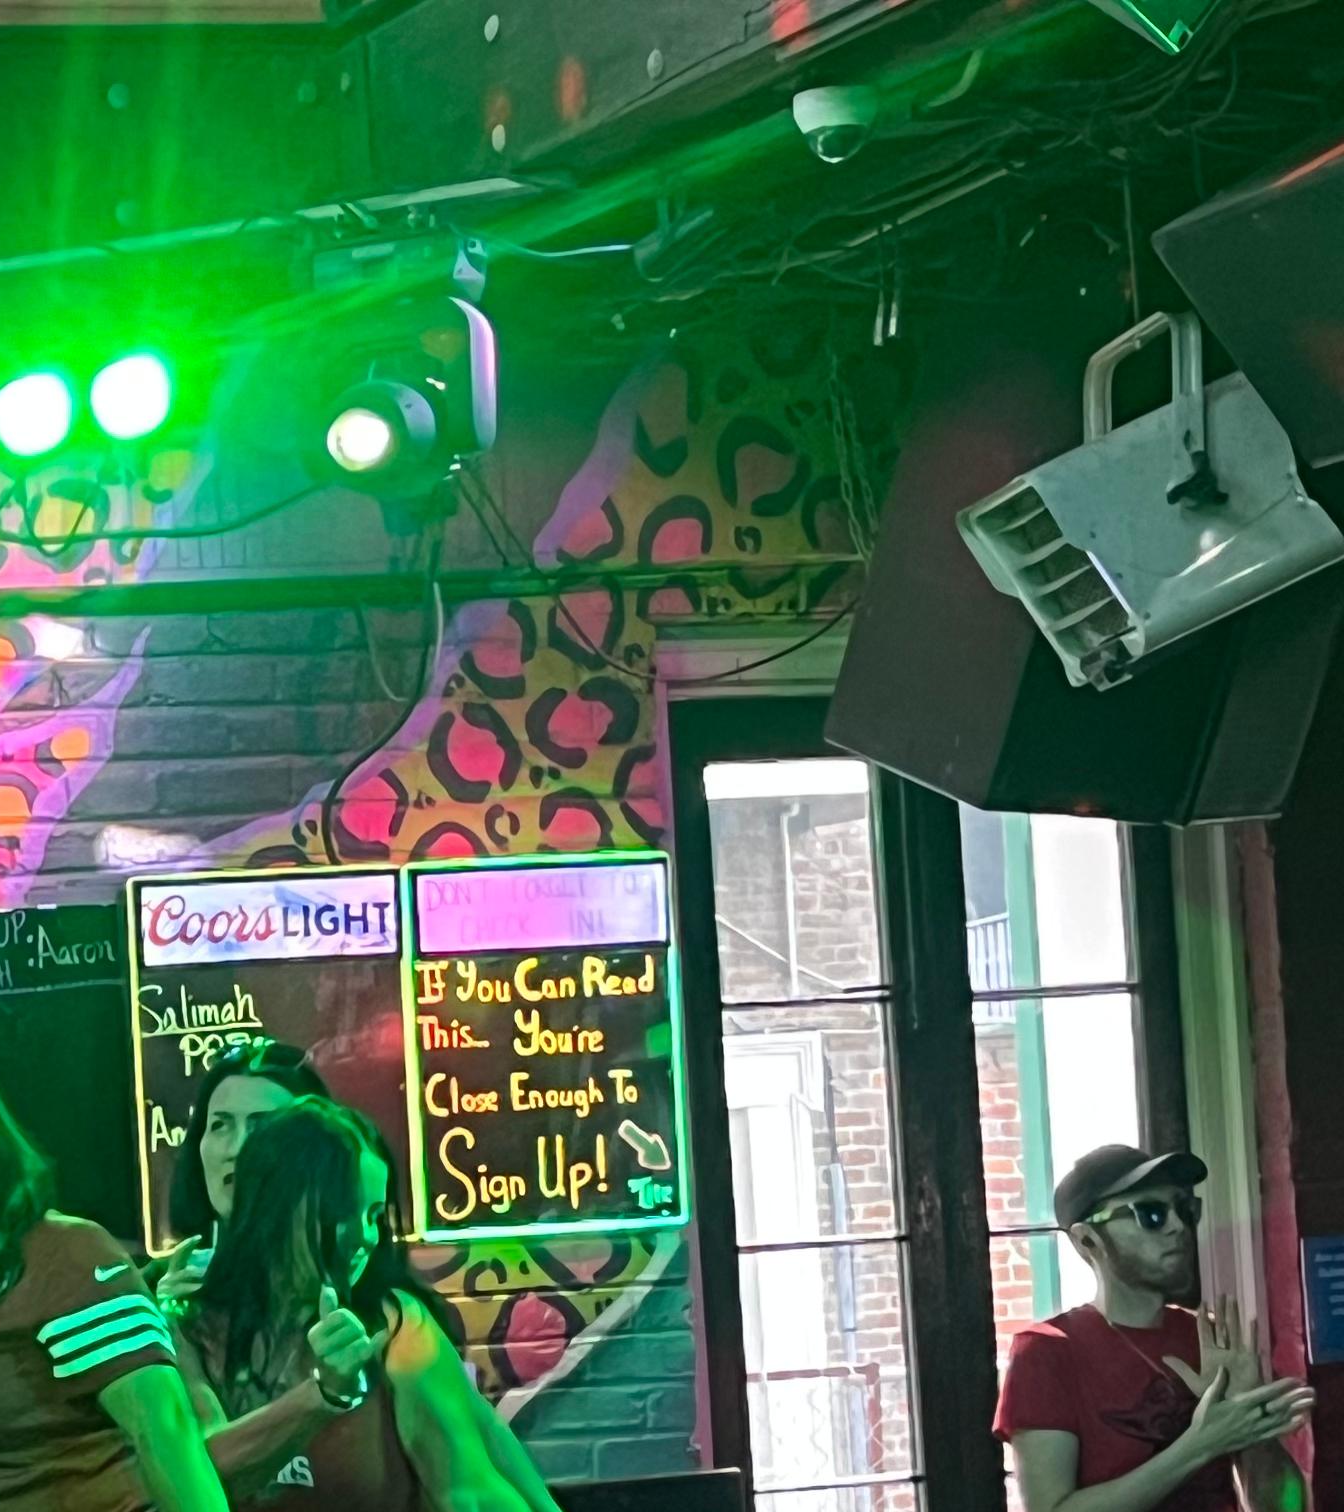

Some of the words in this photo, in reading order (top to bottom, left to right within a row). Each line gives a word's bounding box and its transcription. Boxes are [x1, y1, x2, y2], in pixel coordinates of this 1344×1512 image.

[143, 894, 279, 948] Coors
[282, 901, 391, 938] LIGHT
[456, 960, 512, 1004] You
[513, 957, 576, 1002] Can
[582, 954, 655, 998] Read
[137, 983, 263, 1036] Salimah
[424, 1072, 500, 1118] Close
[509, 1071, 604, 1118] Enough
[607, 1068, 639, 1104] To
[435, 1126, 527, 1222] Sign
[536, 1133, 609, 1210] Up!
